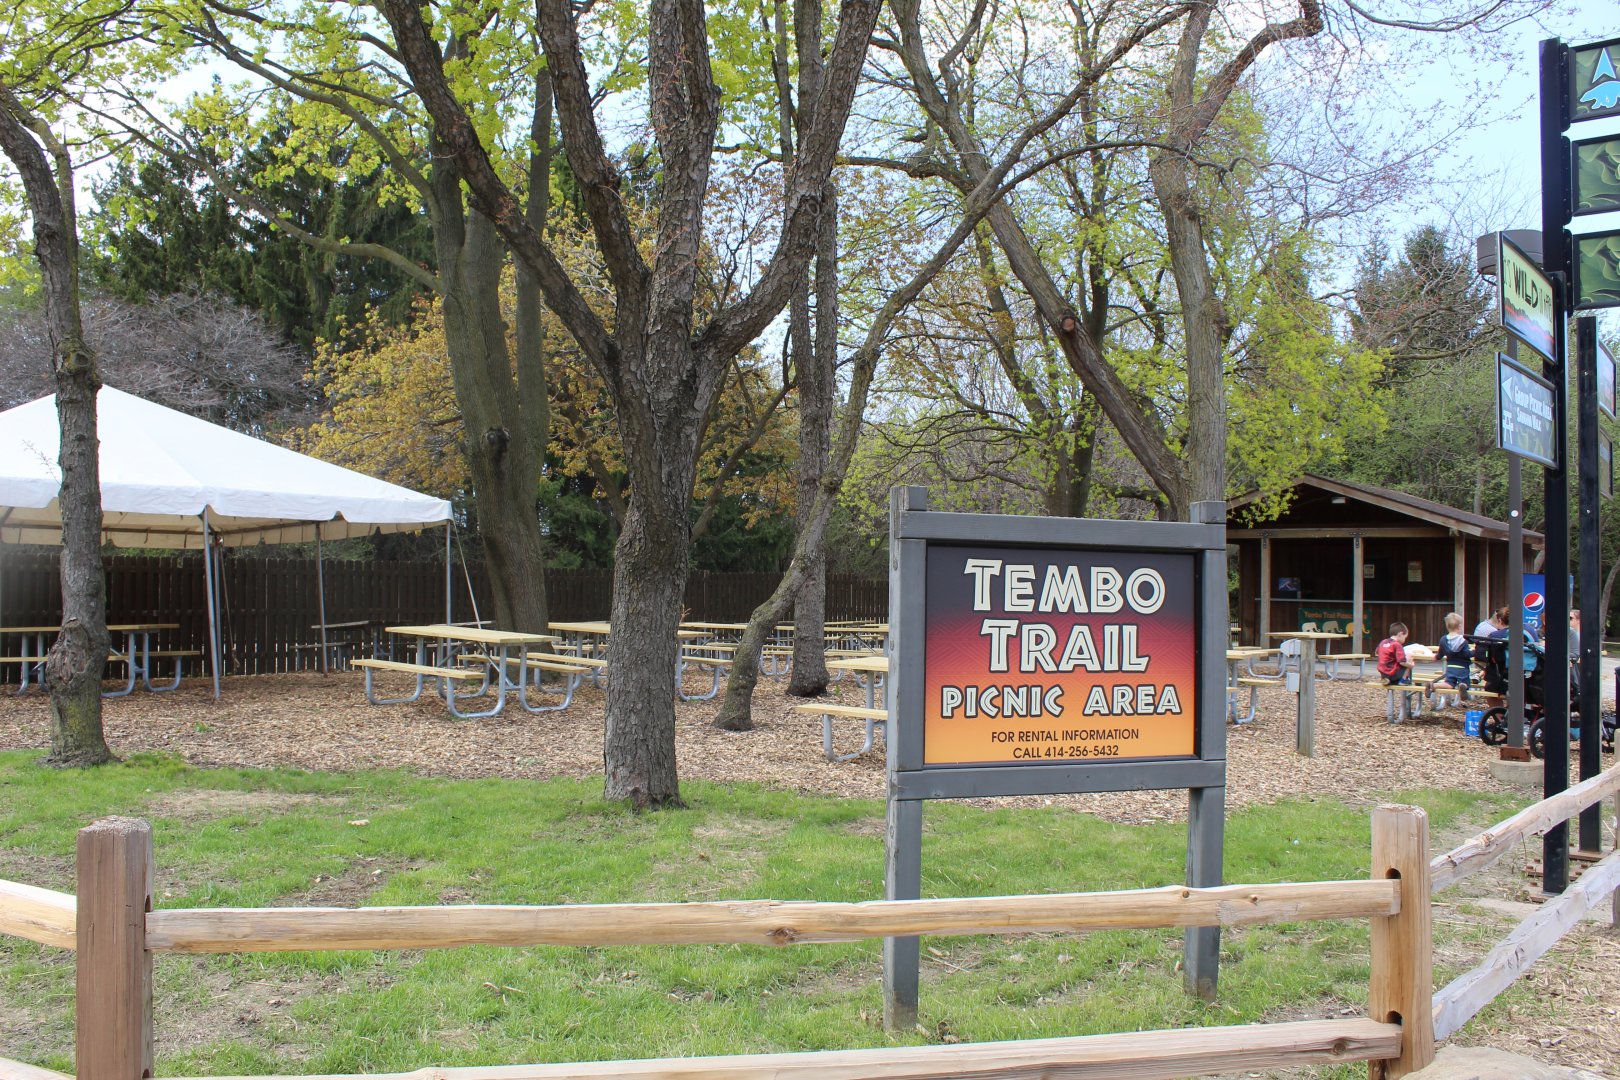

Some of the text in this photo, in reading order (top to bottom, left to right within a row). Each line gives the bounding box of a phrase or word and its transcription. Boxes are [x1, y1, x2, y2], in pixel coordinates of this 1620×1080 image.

[1512, 262, 1539, 308] WILD
[964, 558, 1166, 615] TEMBO
[980, 618, 1150, 673] TRAIL
[941, 684, 1183, 719] PICNIC AREA
[991, 728, 1139, 743] FOR RENTAL INFORMATION
[1013, 745, 1119, 759] CALL 414-256-5432
